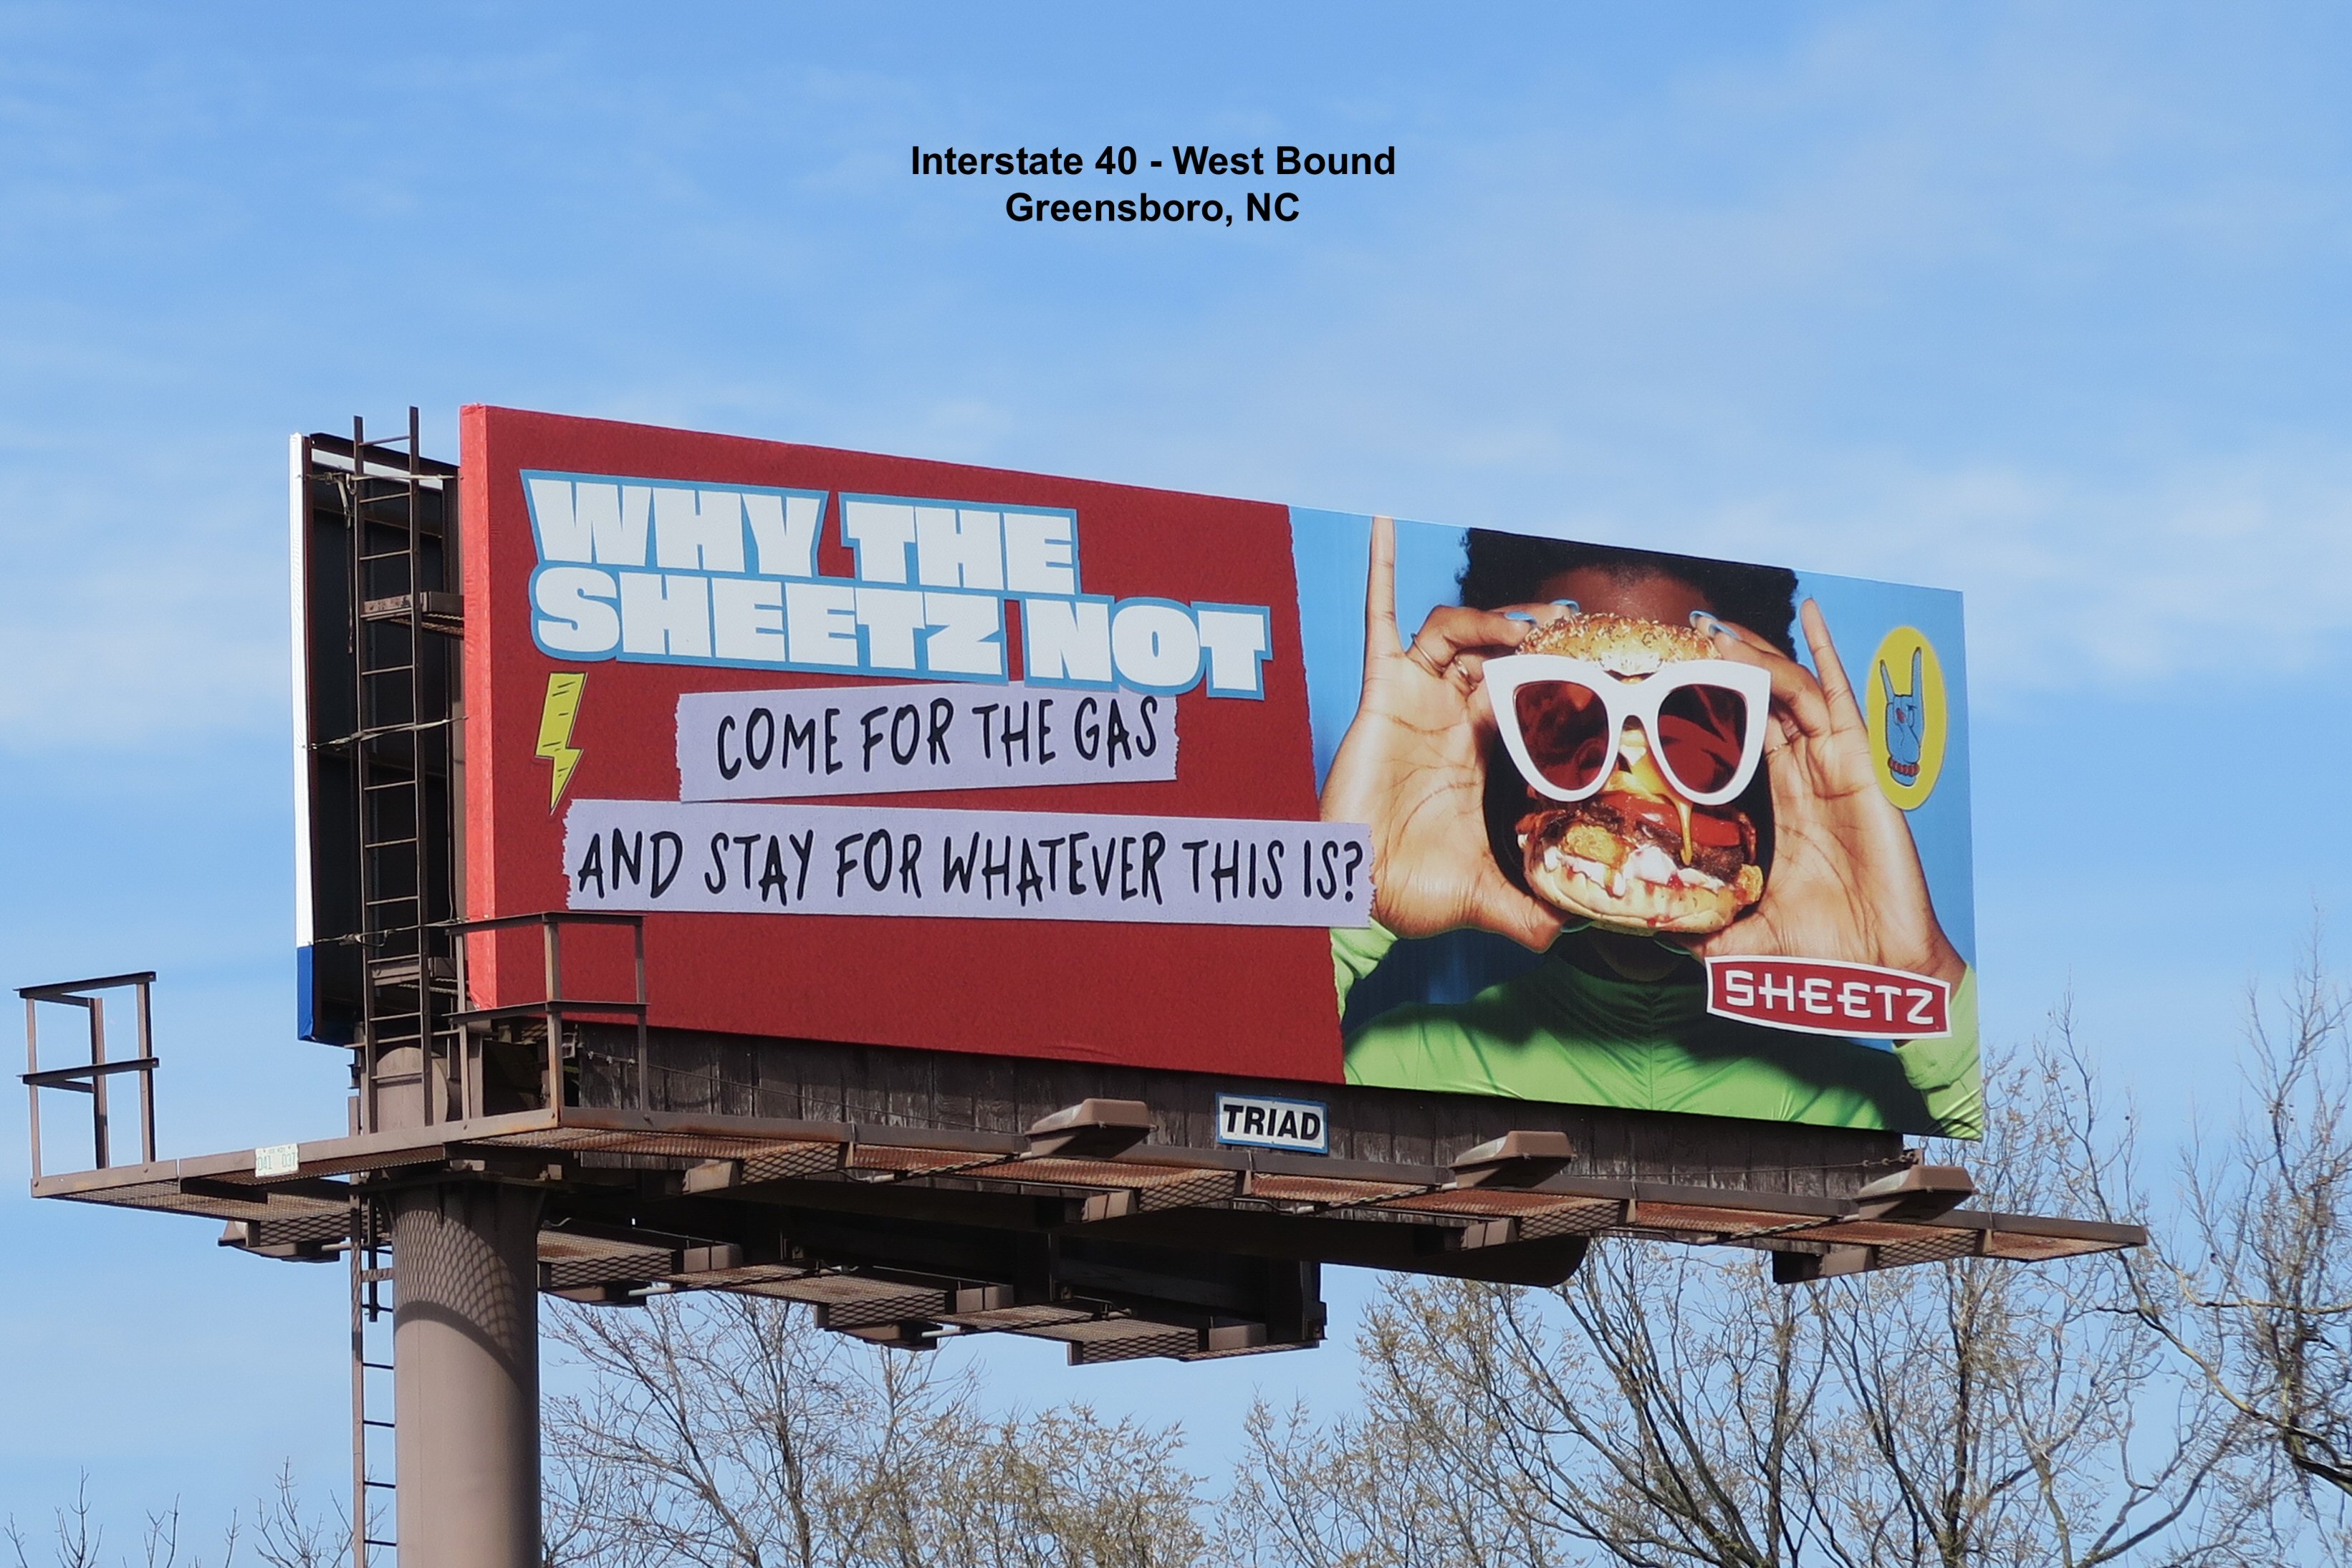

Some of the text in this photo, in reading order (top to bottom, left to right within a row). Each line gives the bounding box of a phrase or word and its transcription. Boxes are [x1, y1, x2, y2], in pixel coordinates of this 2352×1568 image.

[524, 474, 1077, 596] WHY THE
[533, 566, 1267, 693] SHEETZ NOT
[717, 696, 1158, 780] COME FOR THE GAS
[577, 827, 1364, 907] AND STAY FOR WHATEVER THIS IS?
[1724, 969, 1935, 1025] SHEETZ
[1223, 1103, 1321, 1141] TRIAD
